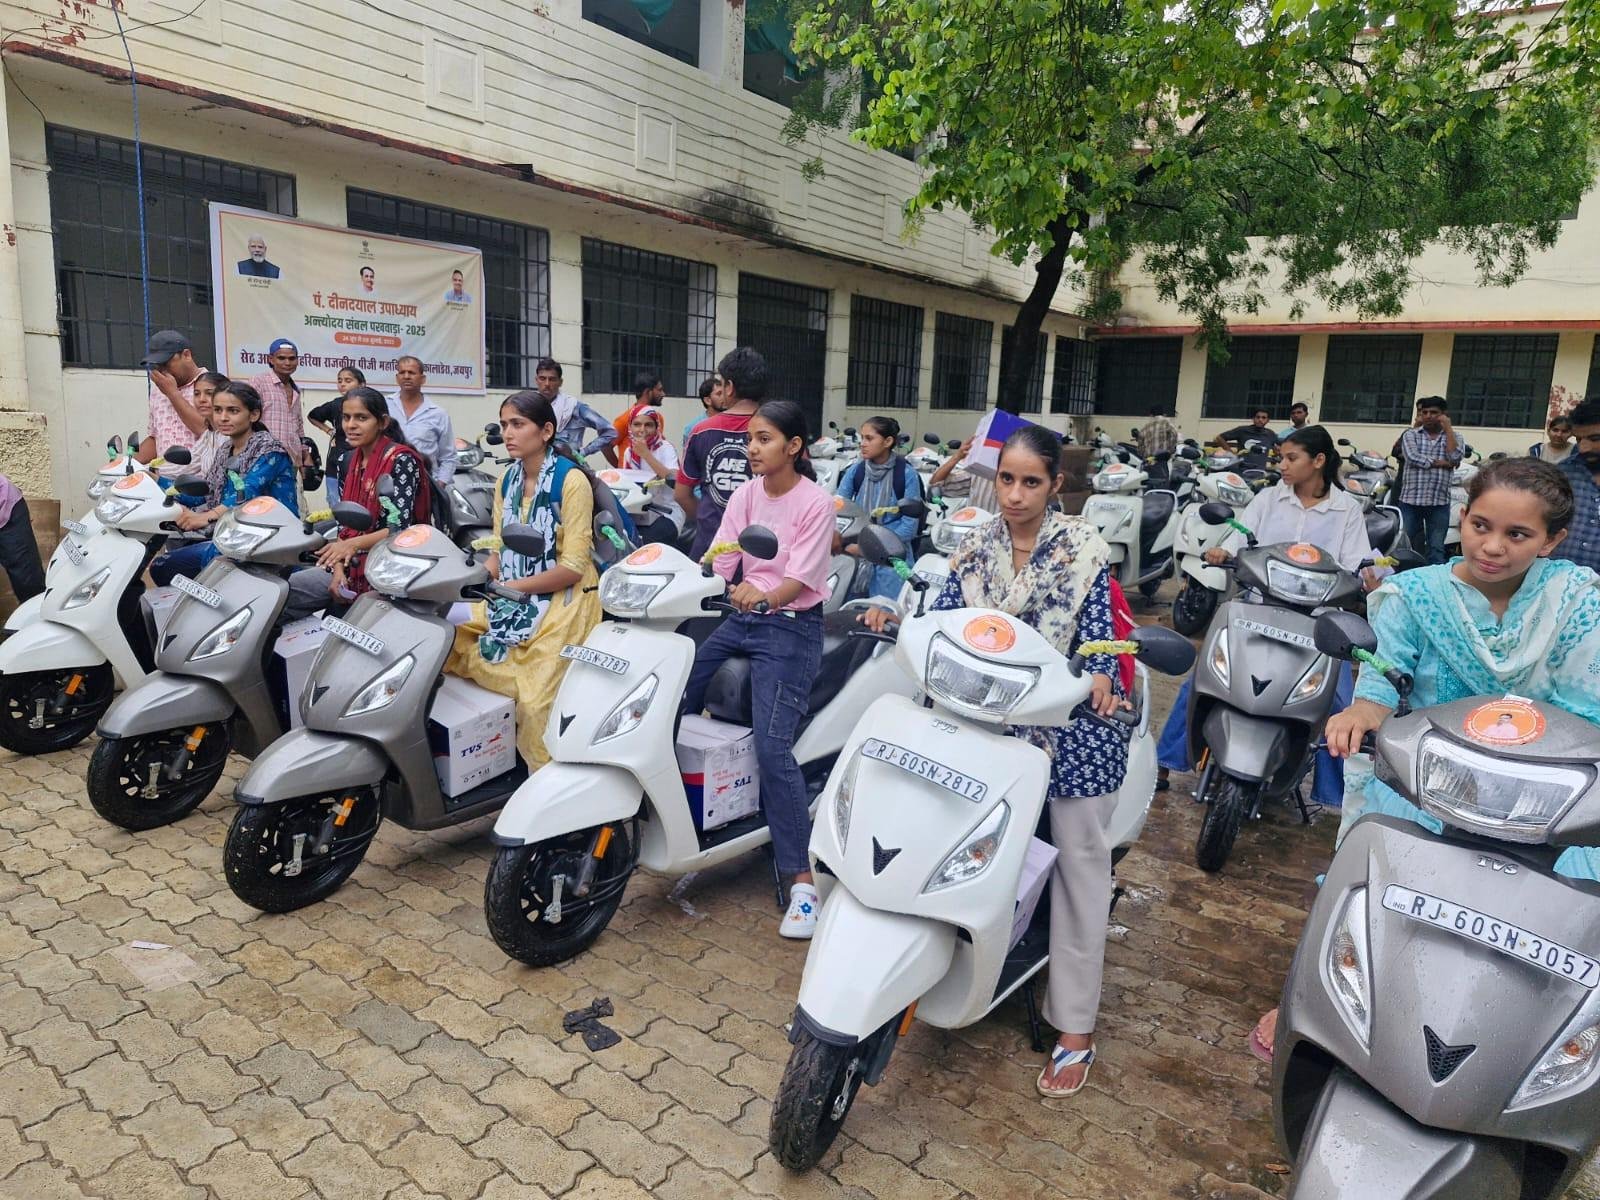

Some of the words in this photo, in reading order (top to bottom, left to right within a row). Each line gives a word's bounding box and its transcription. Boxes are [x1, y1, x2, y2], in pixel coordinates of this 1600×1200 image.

[312, 291, 325, 309] पं.
[327, 292, 376, 314] दीनदयाल
[378, 301, 418, 318] उपाध्याय
[406, 324, 426, 337] 2025
[239, 349, 255, 364] सेठ
[324, 355, 356, 368] राजकीय
[358, 357, 377, 371] पीजी
[717, 457, 748, 472] ARE
[460, 742, 483, 758] TVS
[734, 775, 752, 788] TVS
[1476, 855, 1520, 876] TVS
